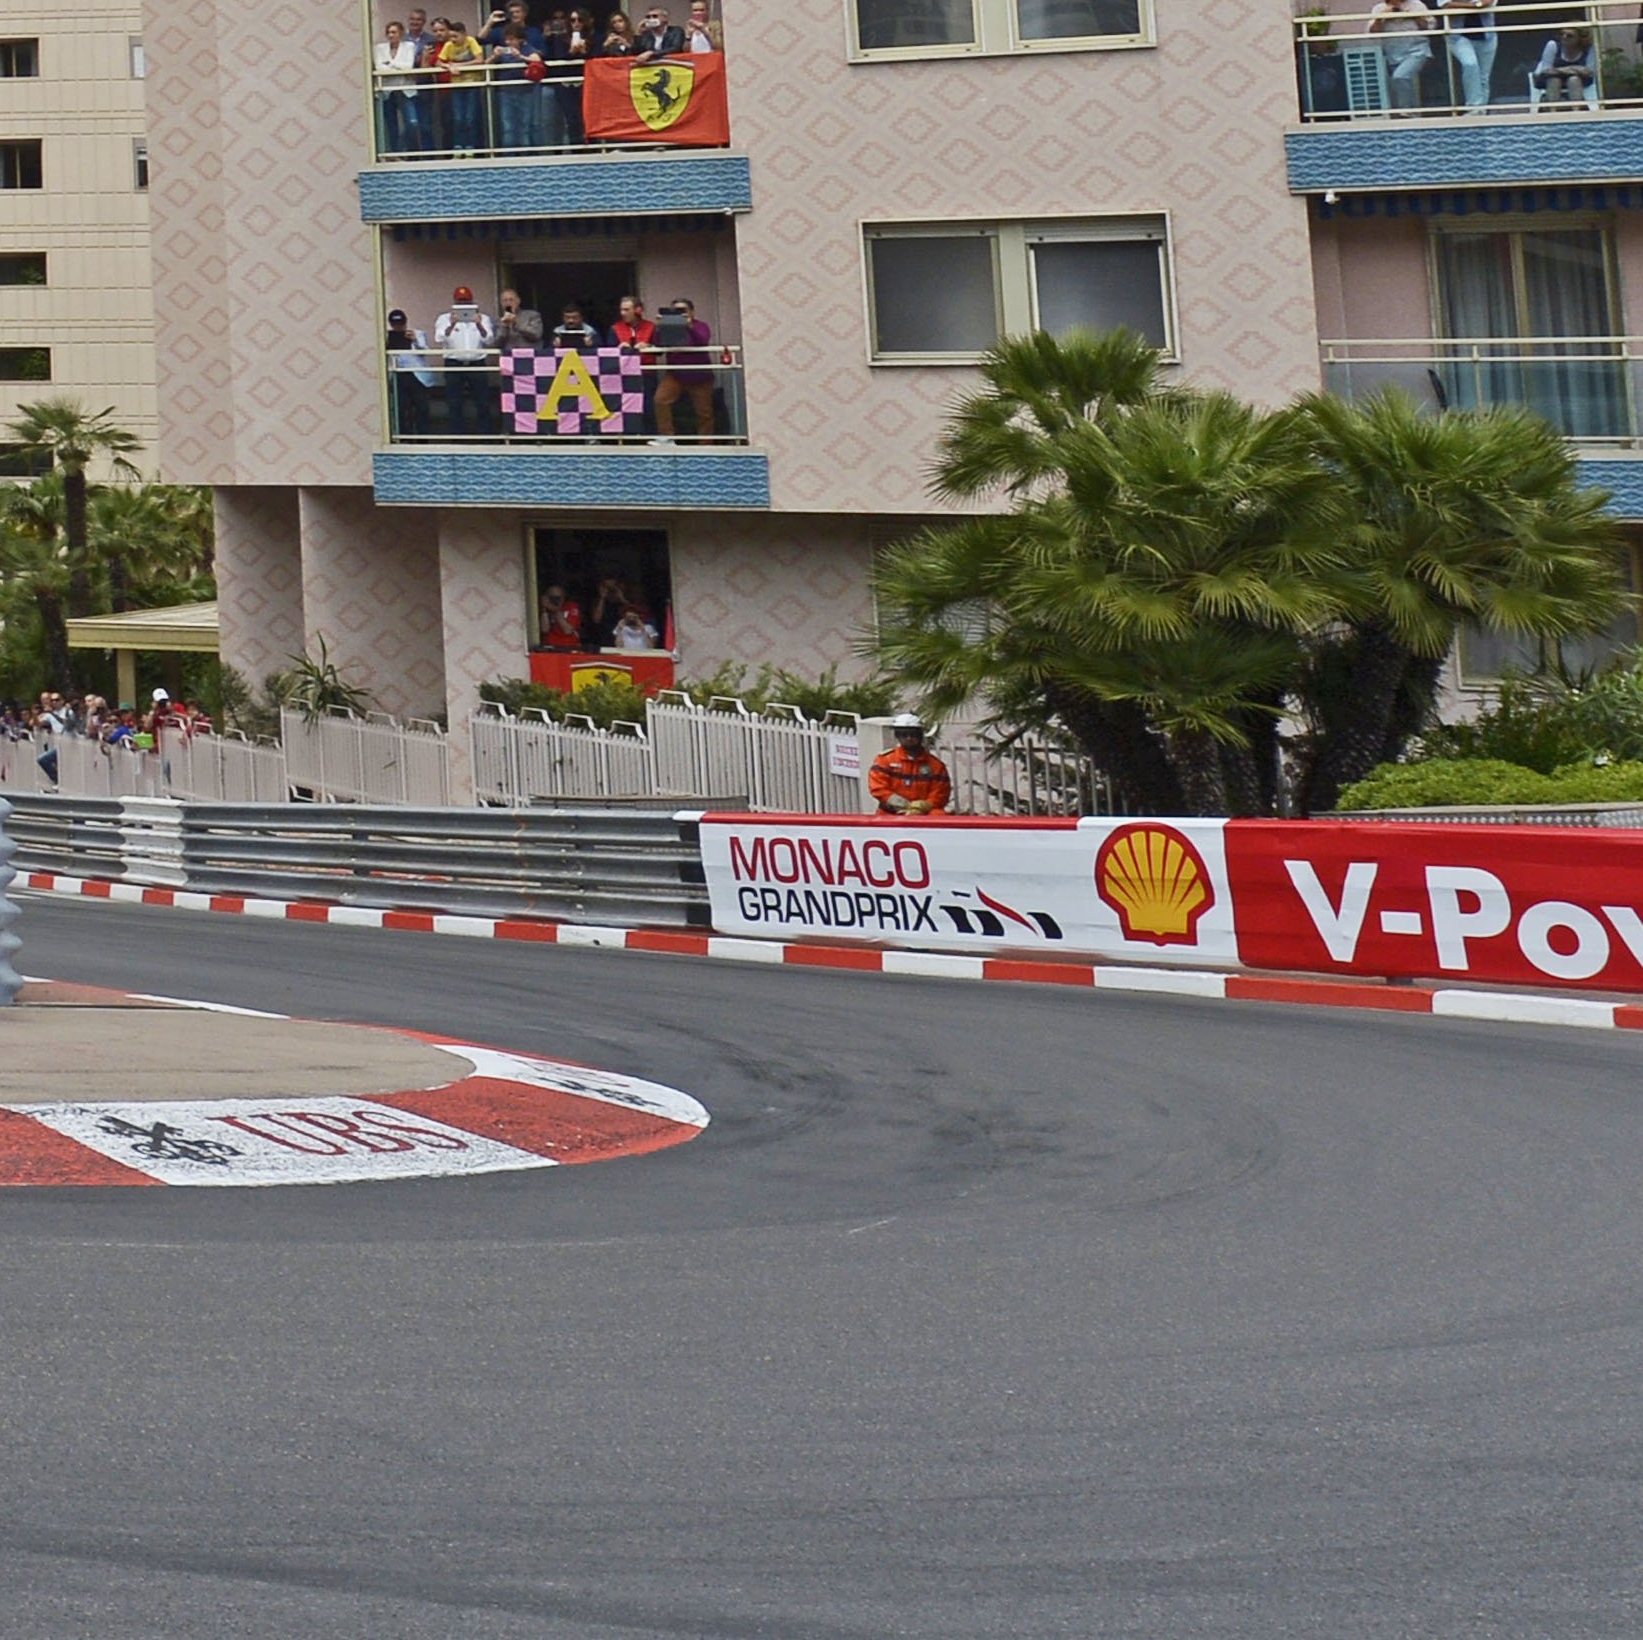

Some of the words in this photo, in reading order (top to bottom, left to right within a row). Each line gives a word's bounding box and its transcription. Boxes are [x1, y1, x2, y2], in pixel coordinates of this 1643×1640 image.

[536, 349, 611, 420] A
[729, 836, 930, 889] MONACO
[738, 887, 939, 933] GRANDPRIX
[206, 1111, 469, 1155] UBS
